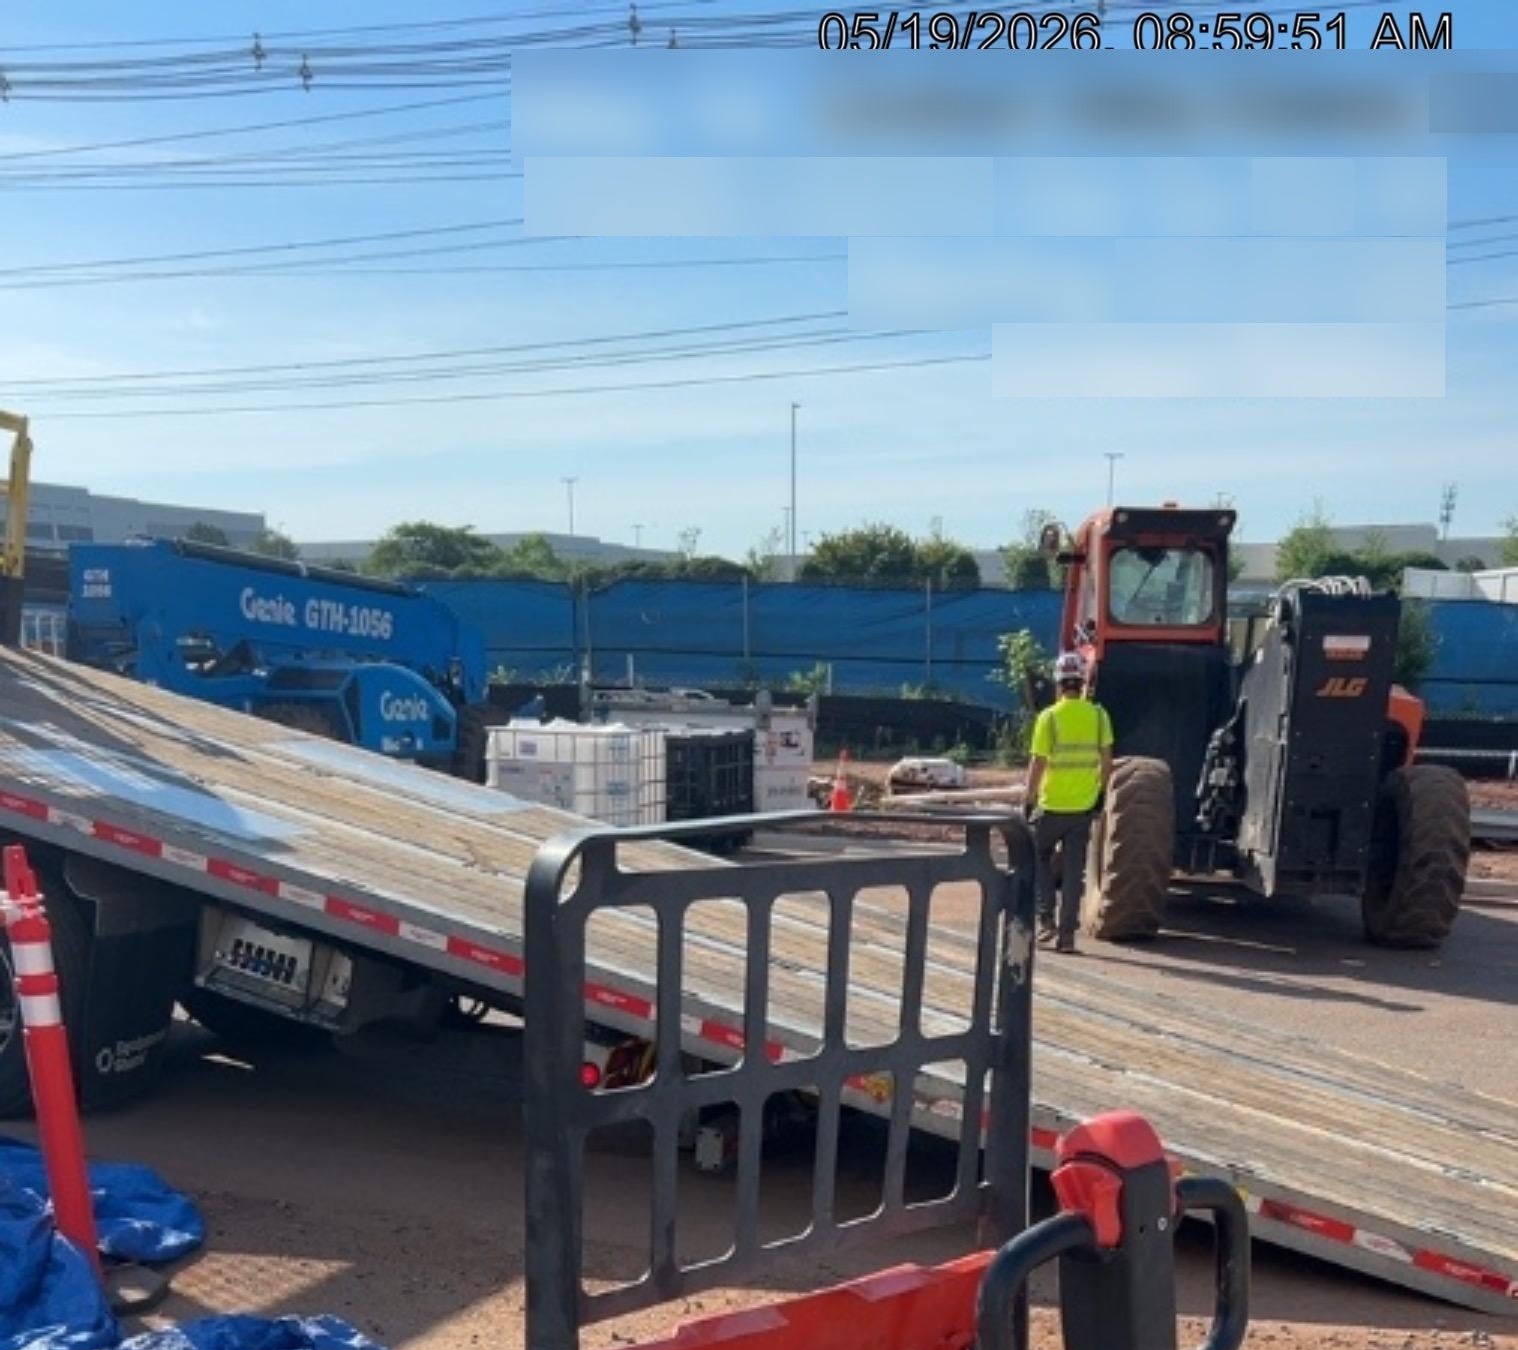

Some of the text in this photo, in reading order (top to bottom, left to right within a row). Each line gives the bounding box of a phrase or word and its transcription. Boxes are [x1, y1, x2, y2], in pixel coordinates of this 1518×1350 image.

[240, 586, 393, 640] Genie GTH-1056
[1316, 677, 1369, 697] JLG
[381, 689, 429, 721] Genie
